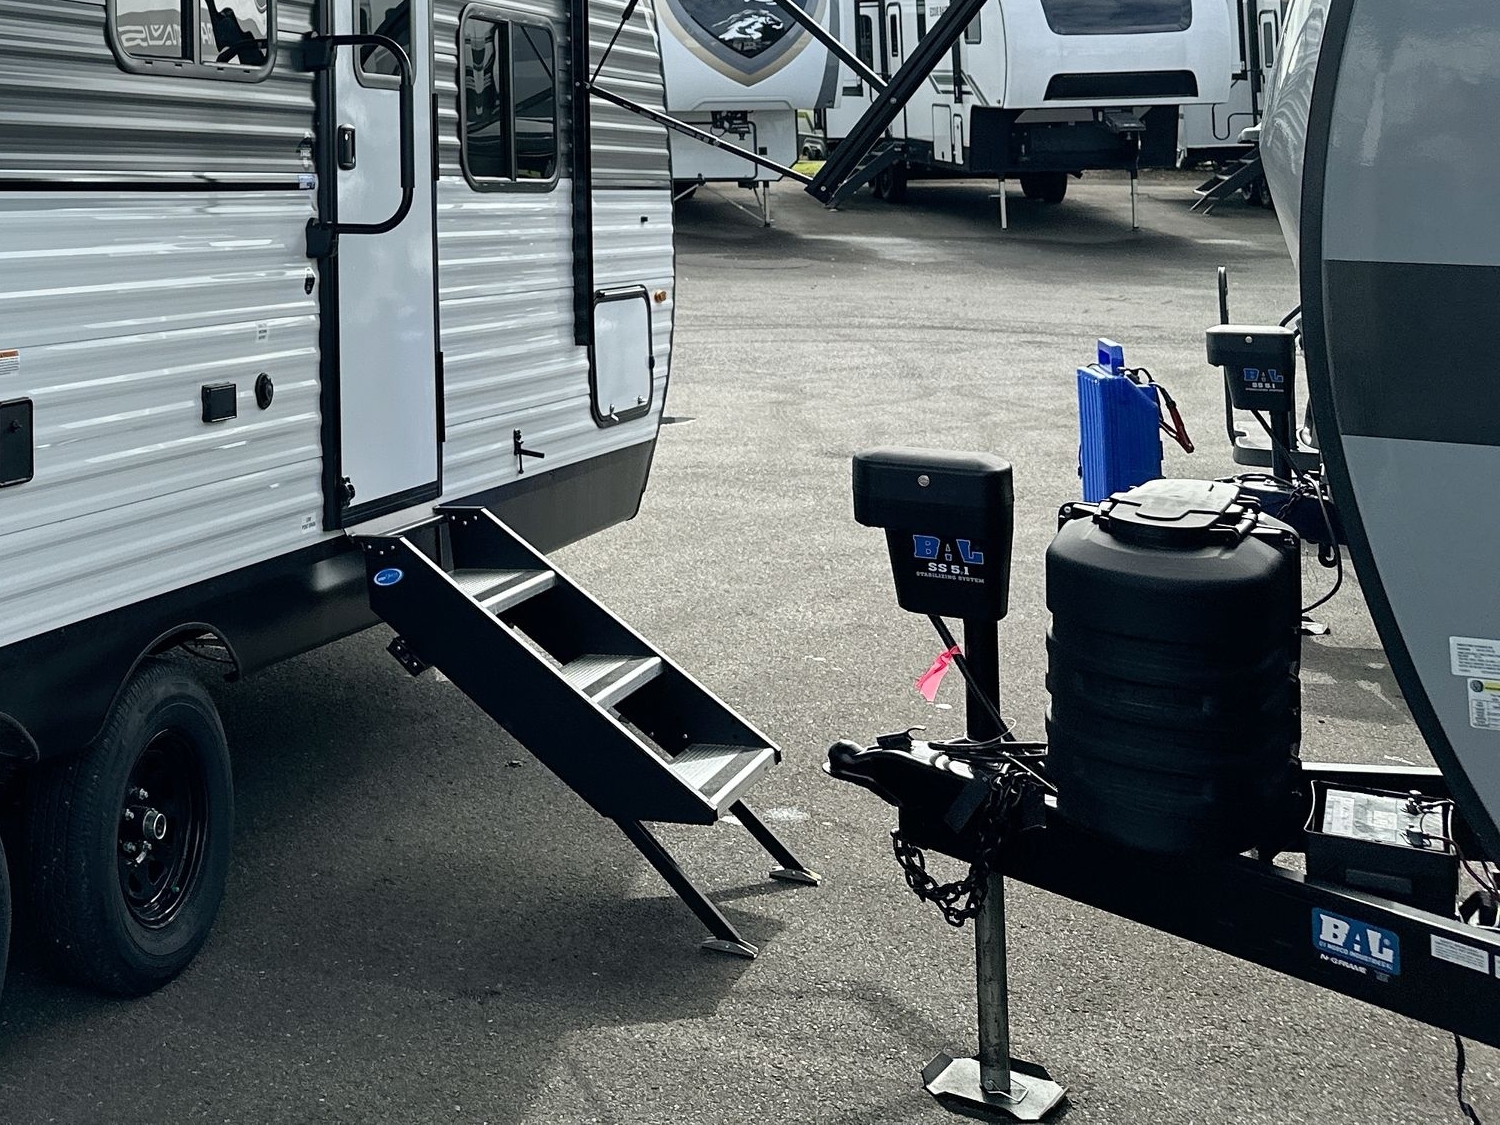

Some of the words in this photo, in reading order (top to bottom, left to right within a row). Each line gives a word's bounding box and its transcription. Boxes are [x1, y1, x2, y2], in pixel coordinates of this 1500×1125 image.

[928, 562, 948, 573] SS
[950, 565, 970, 576] 5.1
[915, 571, 957, 580] STABILIZING
[957, 576, 985, 584] SYSTEM
